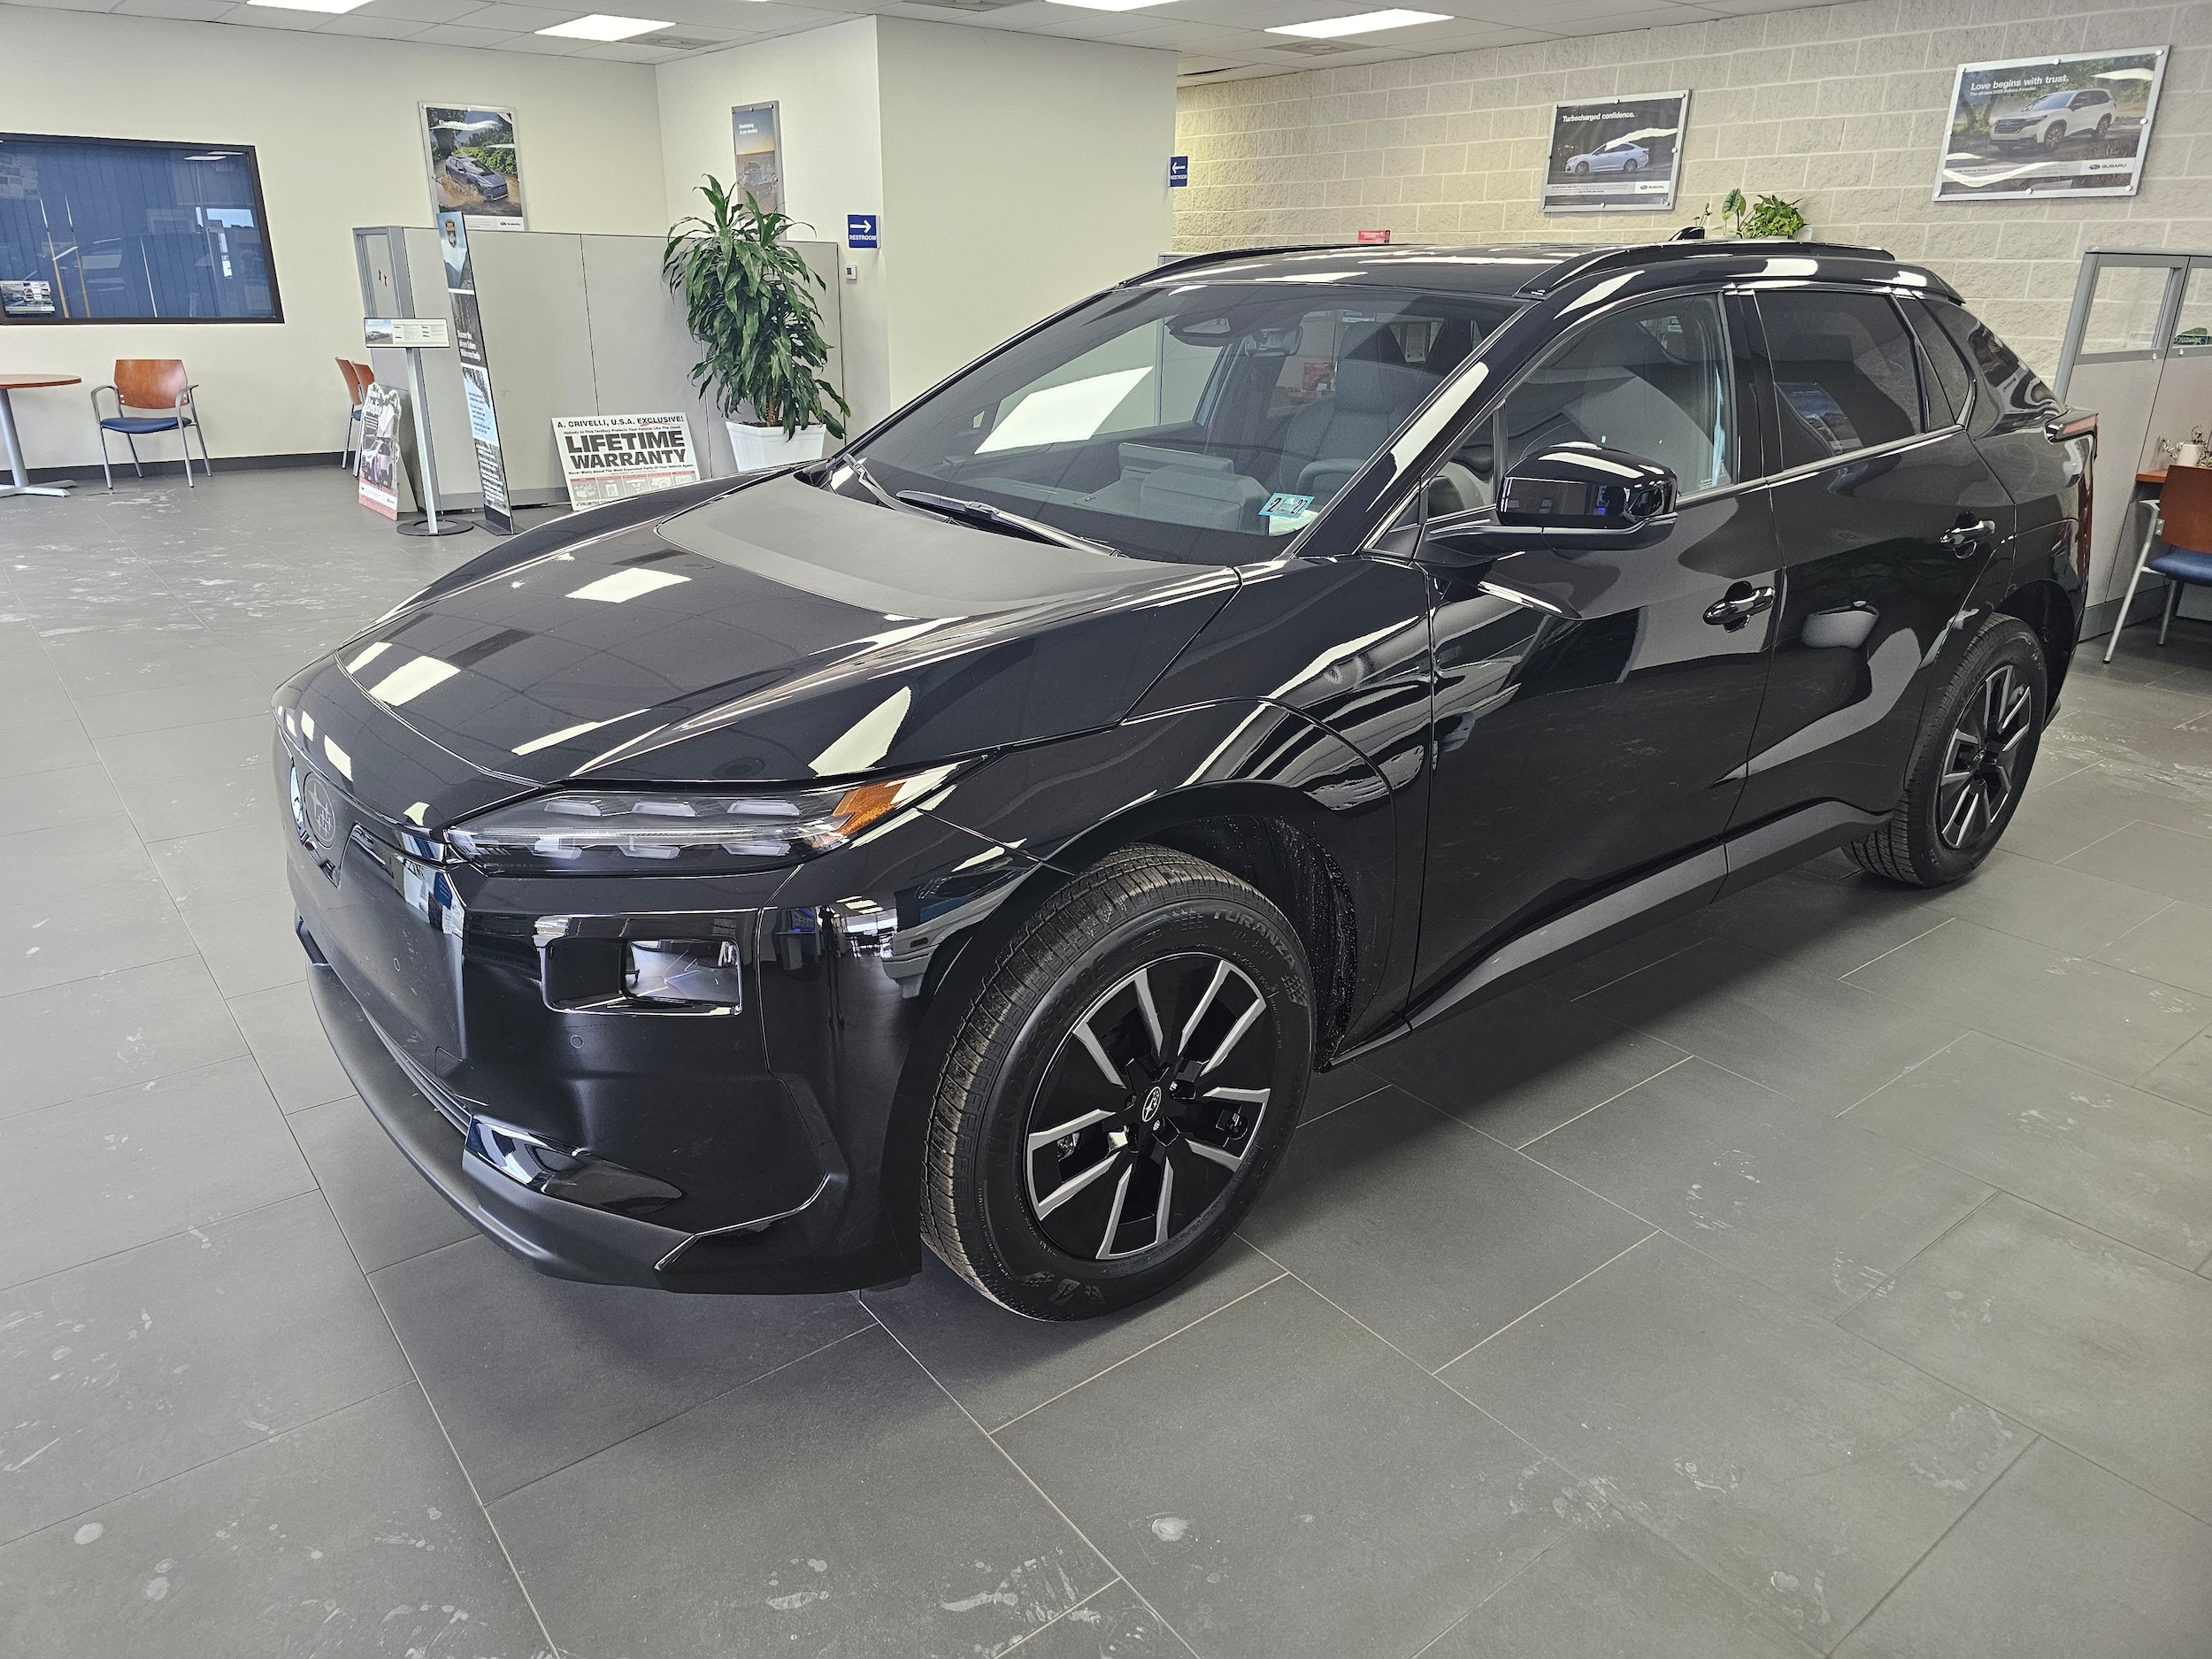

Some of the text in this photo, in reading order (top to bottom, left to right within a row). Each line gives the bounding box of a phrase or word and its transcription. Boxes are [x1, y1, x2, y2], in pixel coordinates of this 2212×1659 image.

[1970, 74, 2070, 91] Love begins with trust.
[1562, 113, 1601, 123] Turbocharged
[565, 430, 686, 453] LIFETIME
[570, 449, 686, 469] WARRANTY
[1266, 497, 1282, 512] 2
[1290, 499, 1309, 516] 27
[1213, 907, 1296, 971] TURANZA
